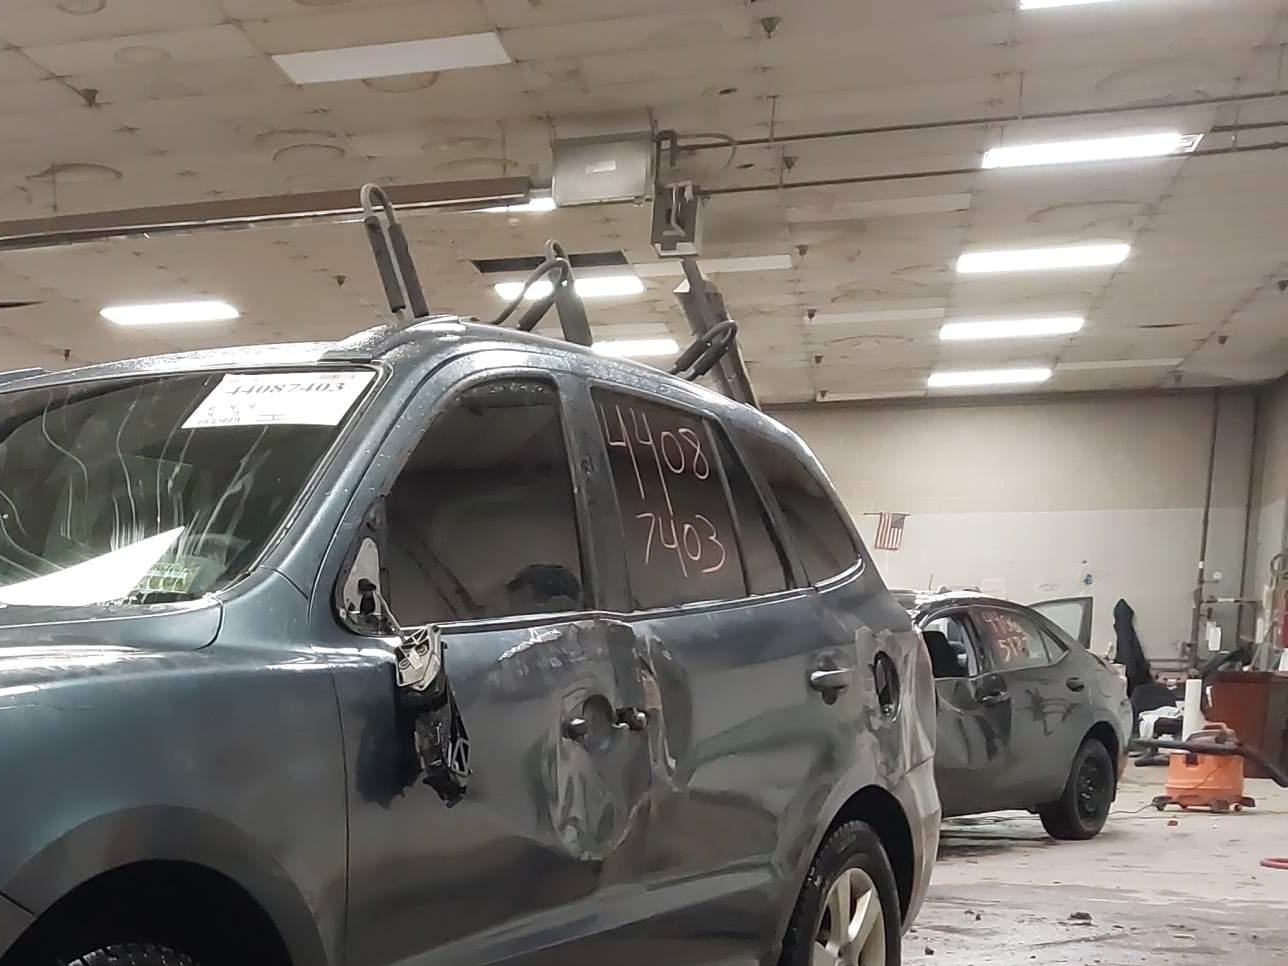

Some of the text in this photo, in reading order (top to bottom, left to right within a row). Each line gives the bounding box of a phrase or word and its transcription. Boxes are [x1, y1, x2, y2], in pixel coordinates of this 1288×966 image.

[226, 382, 345, 395] 44087403
[600, 404, 711, 516] 4408
[635, 512, 726, 578] 7403
